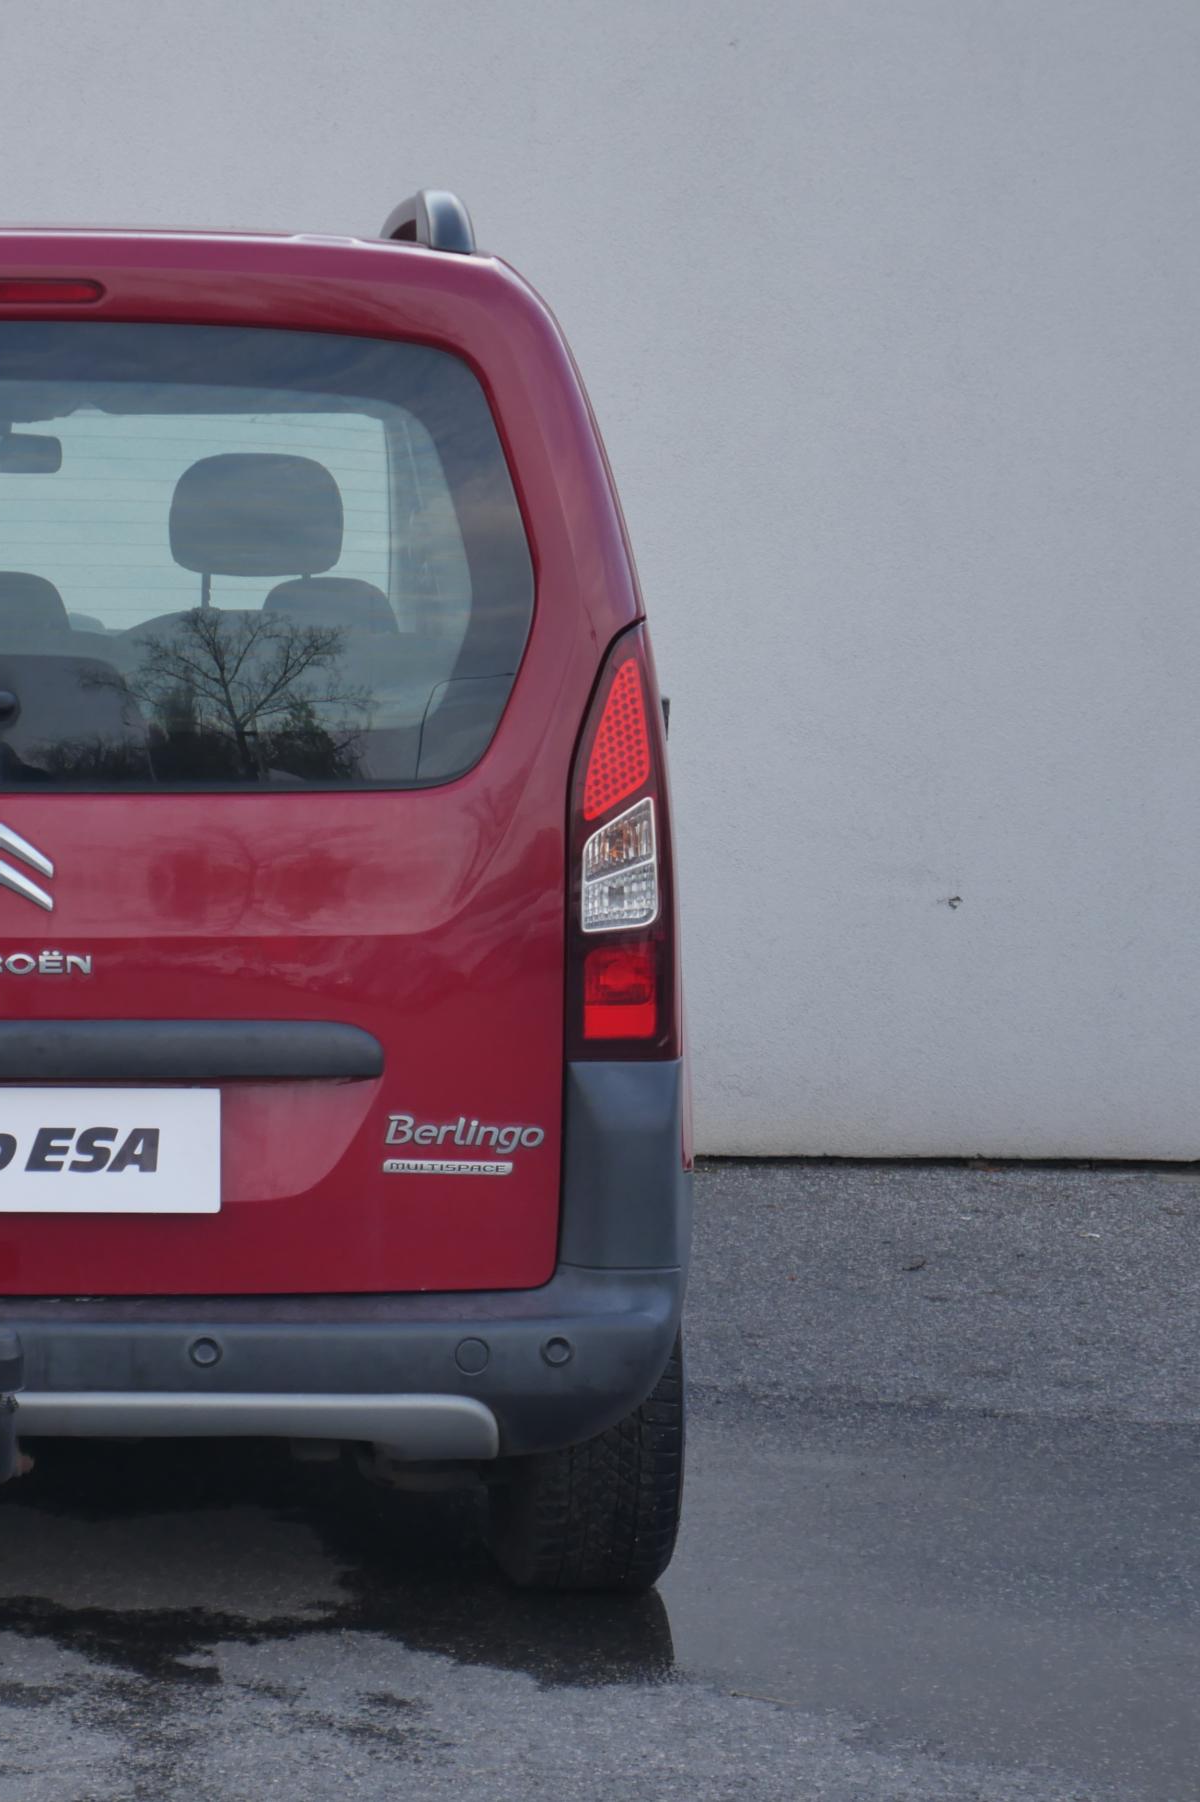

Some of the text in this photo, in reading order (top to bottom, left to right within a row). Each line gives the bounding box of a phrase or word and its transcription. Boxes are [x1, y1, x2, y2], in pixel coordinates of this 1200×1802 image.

[24, 1126, 160, 1173] ESA
[385, 1114, 545, 1154] Berlingo
[389, 1162, 507, 1173] MULTISPACE
